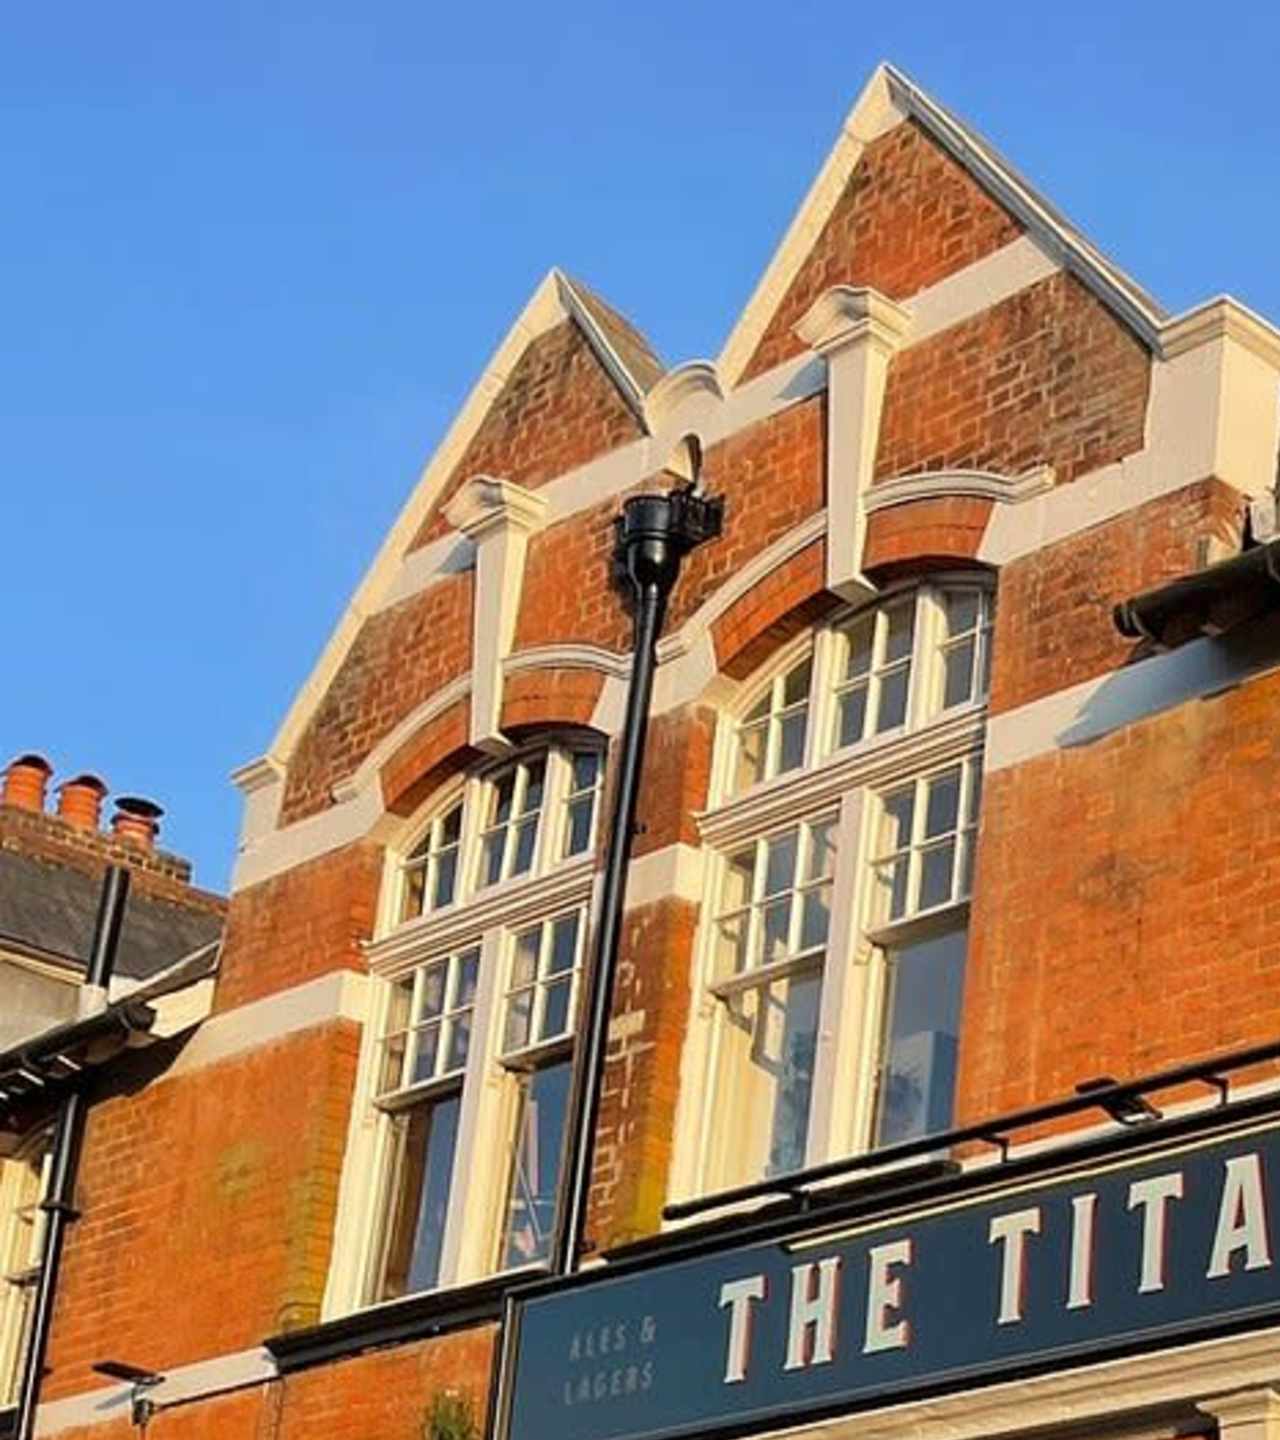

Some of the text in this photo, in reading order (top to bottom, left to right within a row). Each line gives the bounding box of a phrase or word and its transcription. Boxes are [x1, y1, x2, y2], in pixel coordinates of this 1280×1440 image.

[718, 1238, 913, 1385] THE
[569, 1315, 656, 1361] ALES &
[564, 1361, 655, 1406] LAGERS
